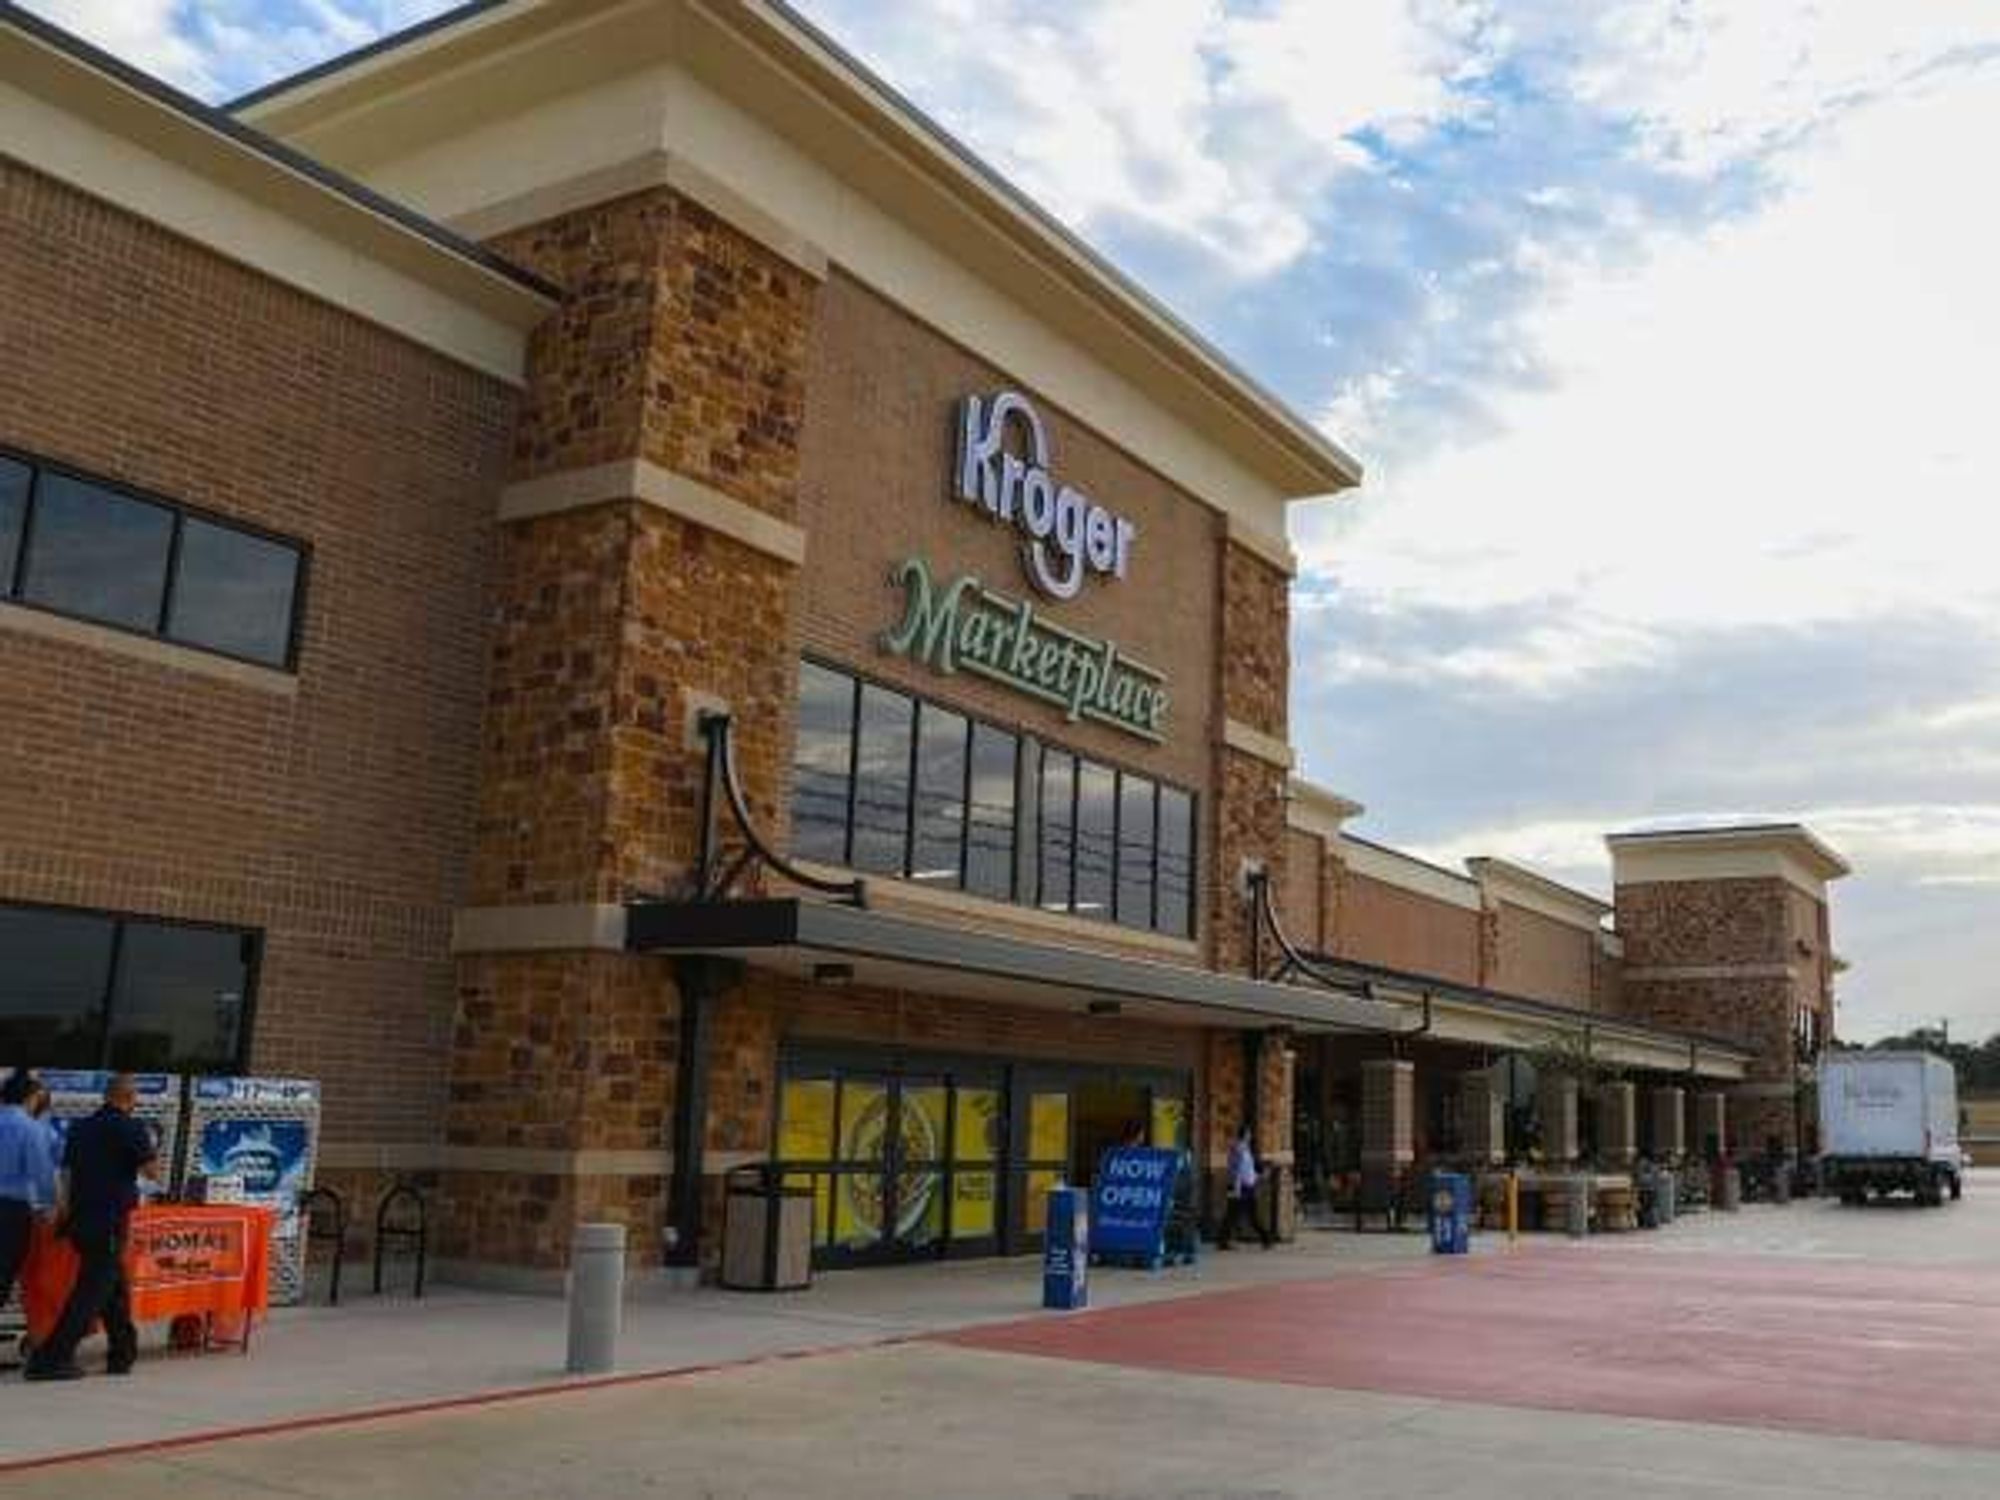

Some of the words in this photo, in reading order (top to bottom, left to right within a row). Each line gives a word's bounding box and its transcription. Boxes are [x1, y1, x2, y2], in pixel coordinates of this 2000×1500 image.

[956, 391, 1135, 598] Kroger
[885, 559, 1172, 722] Marketplace
[1101, 1187, 1162, 1208] OPEN
[1109, 1158, 1166, 1179] NOW
